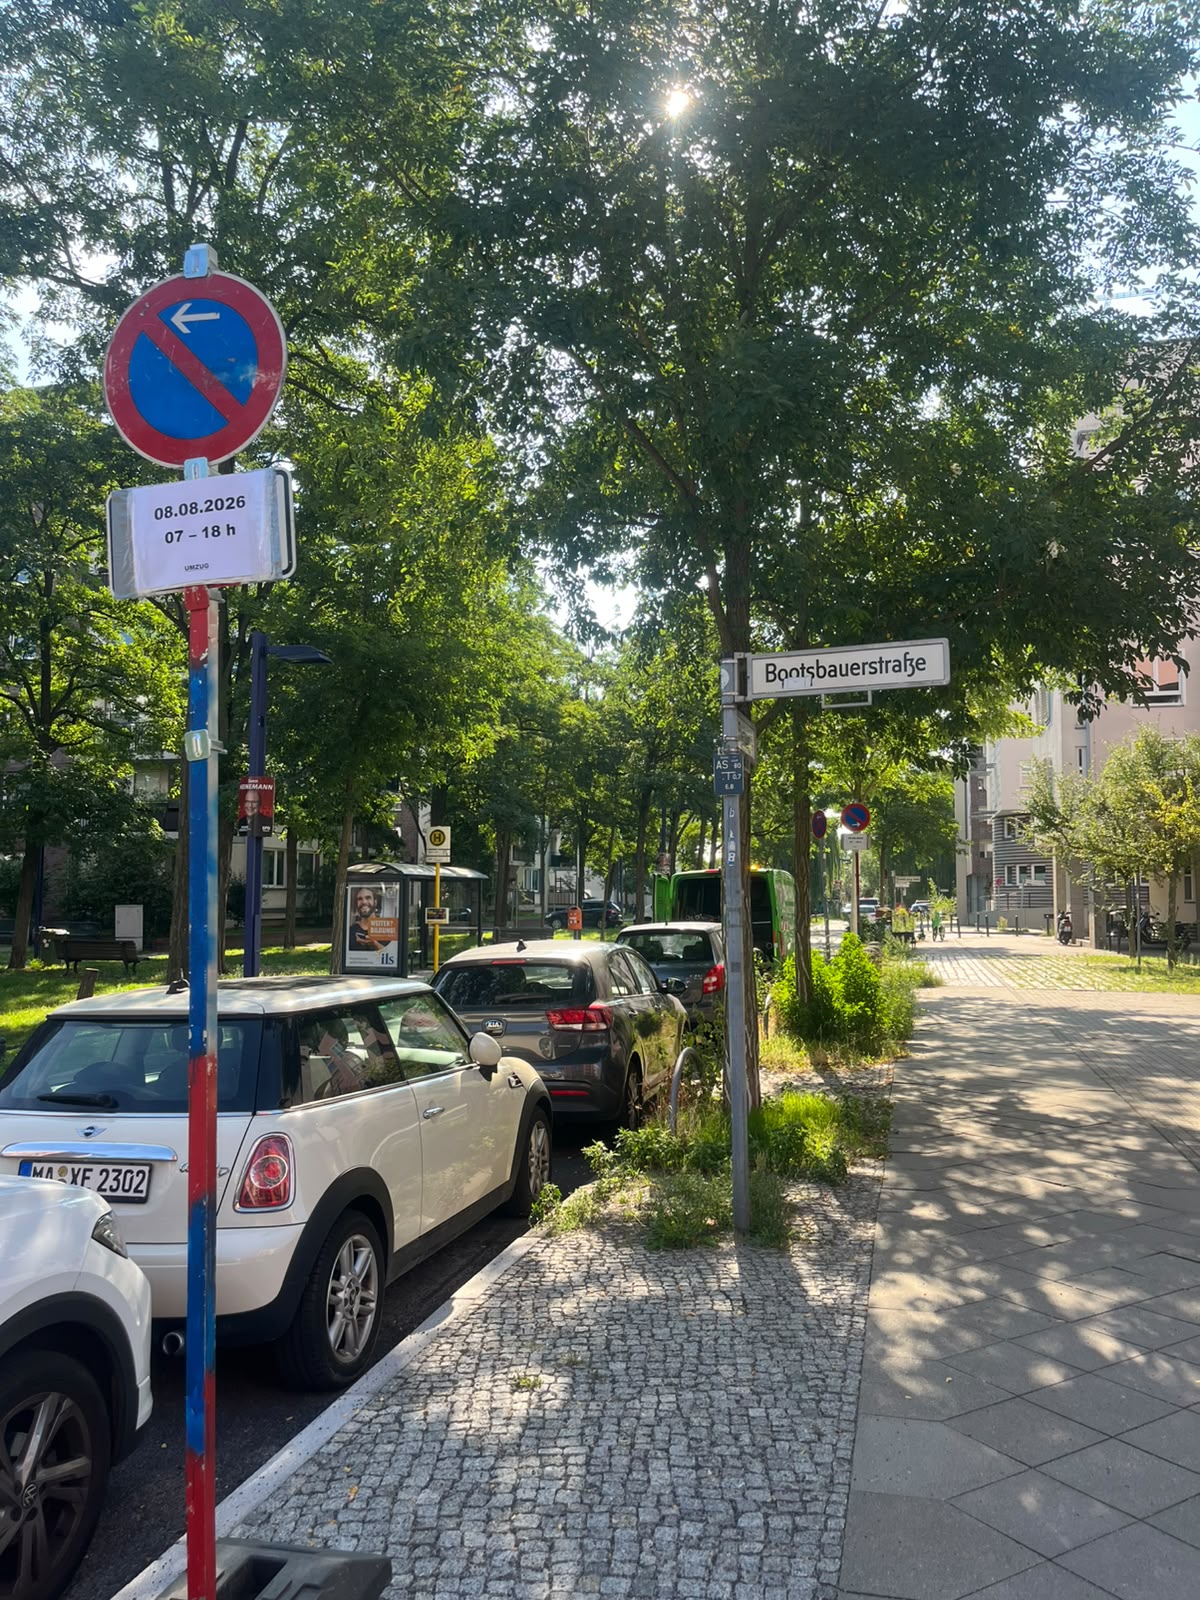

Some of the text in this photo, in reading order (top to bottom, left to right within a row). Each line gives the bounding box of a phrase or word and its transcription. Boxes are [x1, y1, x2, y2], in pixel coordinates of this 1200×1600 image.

[154, 495, 246, 520] 08.08.2026
[165, 530, 184, 544] 07
[202, 525, 221, 539] 18
[226, 524, 236, 536] h
[184, 563, 209, 571] UMZUG
[765, 652, 926, 683] Bootsbauerstraße
[716, 760, 729, 769] AS
[381, 953, 395, 965] ils
[97, 1168, 146, 1194] 2302
